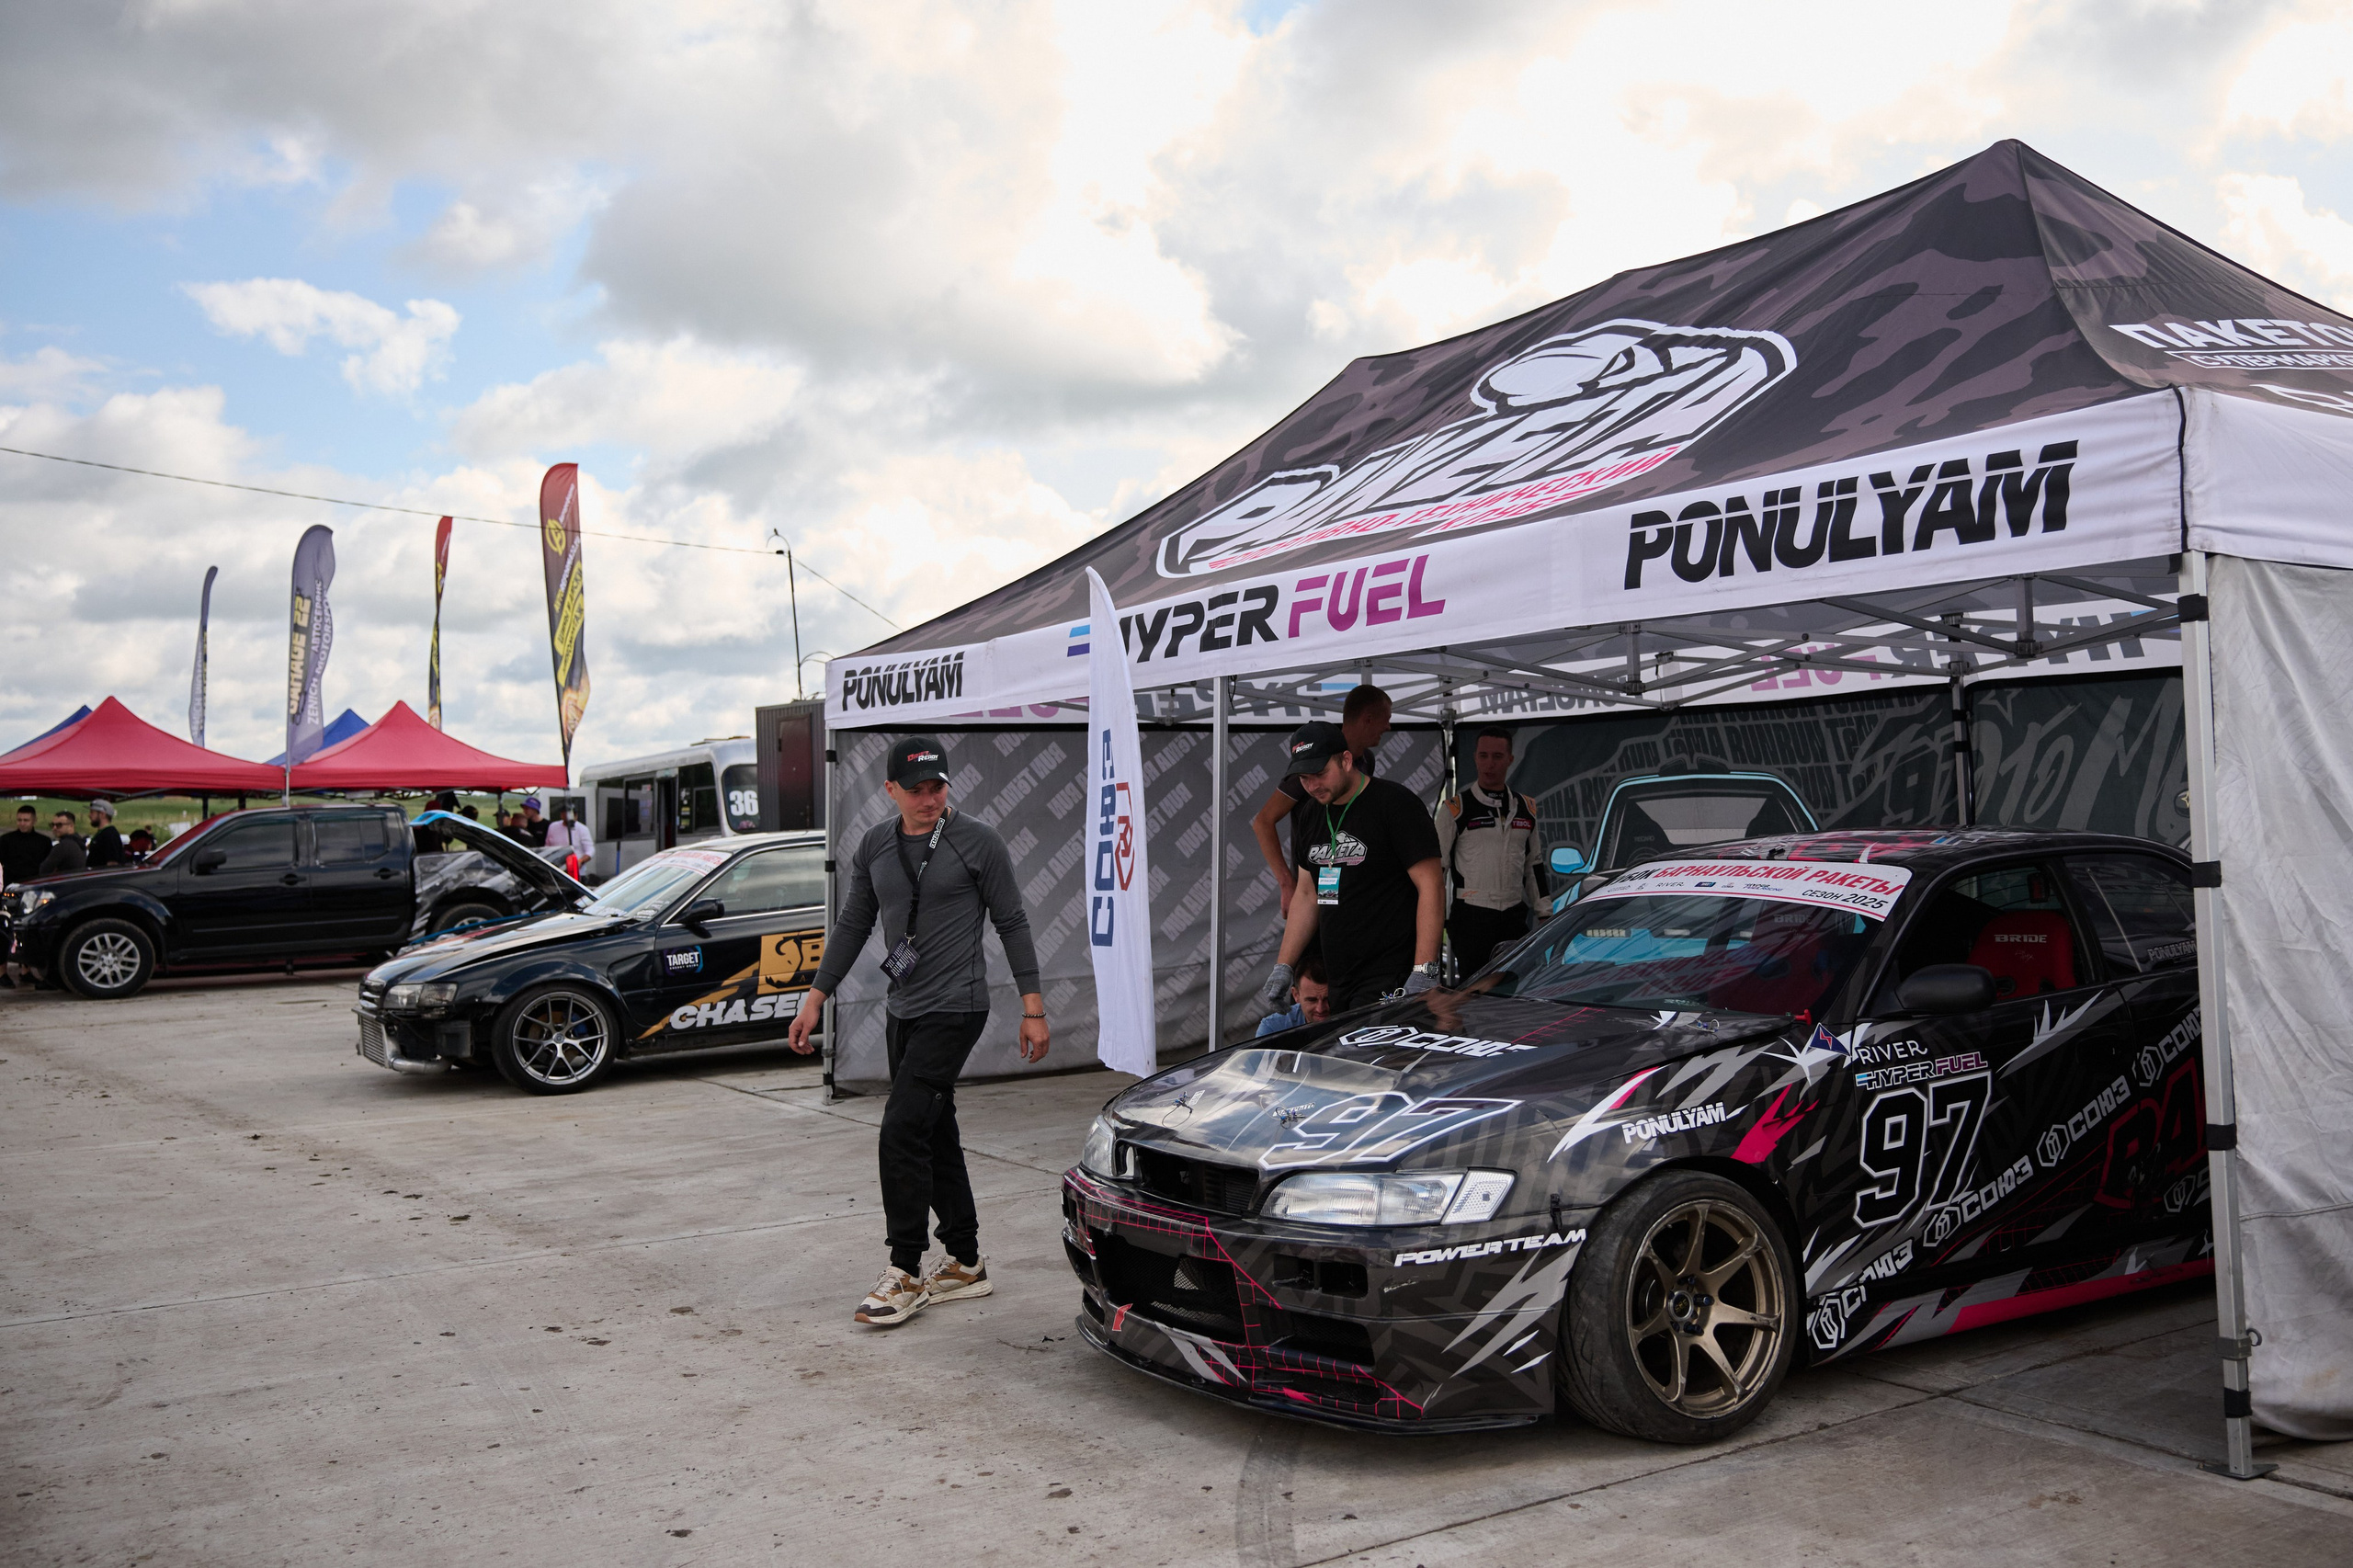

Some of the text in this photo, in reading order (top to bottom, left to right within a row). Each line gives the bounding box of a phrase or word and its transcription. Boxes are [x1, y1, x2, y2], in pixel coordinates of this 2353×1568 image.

[1625, 440, 2078, 589] PONULYAM
[294, 596, 312, 625] 22
[1289, 554, 1446, 639] FUEL
[842, 652, 965, 711] PONULYAM
[729, 790, 759, 816] 36
[1091, 729, 1116, 947] СОЮЗ
[1654, 865, 1810, 881] БАРНАУЛЬСКОЙ
[1805, 872, 1904, 895] РАКЕТЫ
[1802, 889, 1888, 910] СЕЗОН 2025
[666, 951, 699, 965] TARGET
[1994, 934, 2048, 944] BRIDE
[1855, 1051, 1988, 1091] HYPER FUEL
[1858, 1040, 1928, 1065] RIVER
[1622, 1101, 1726, 1144] PONULYAM
[2067, 1074, 2131, 1142] СОЮЗ
[1257, 1090, 1526, 1171] 97
[1852, 1072, 1991, 1229] 97
[1961, 1154, 2034, 1223] СОЮЗ
